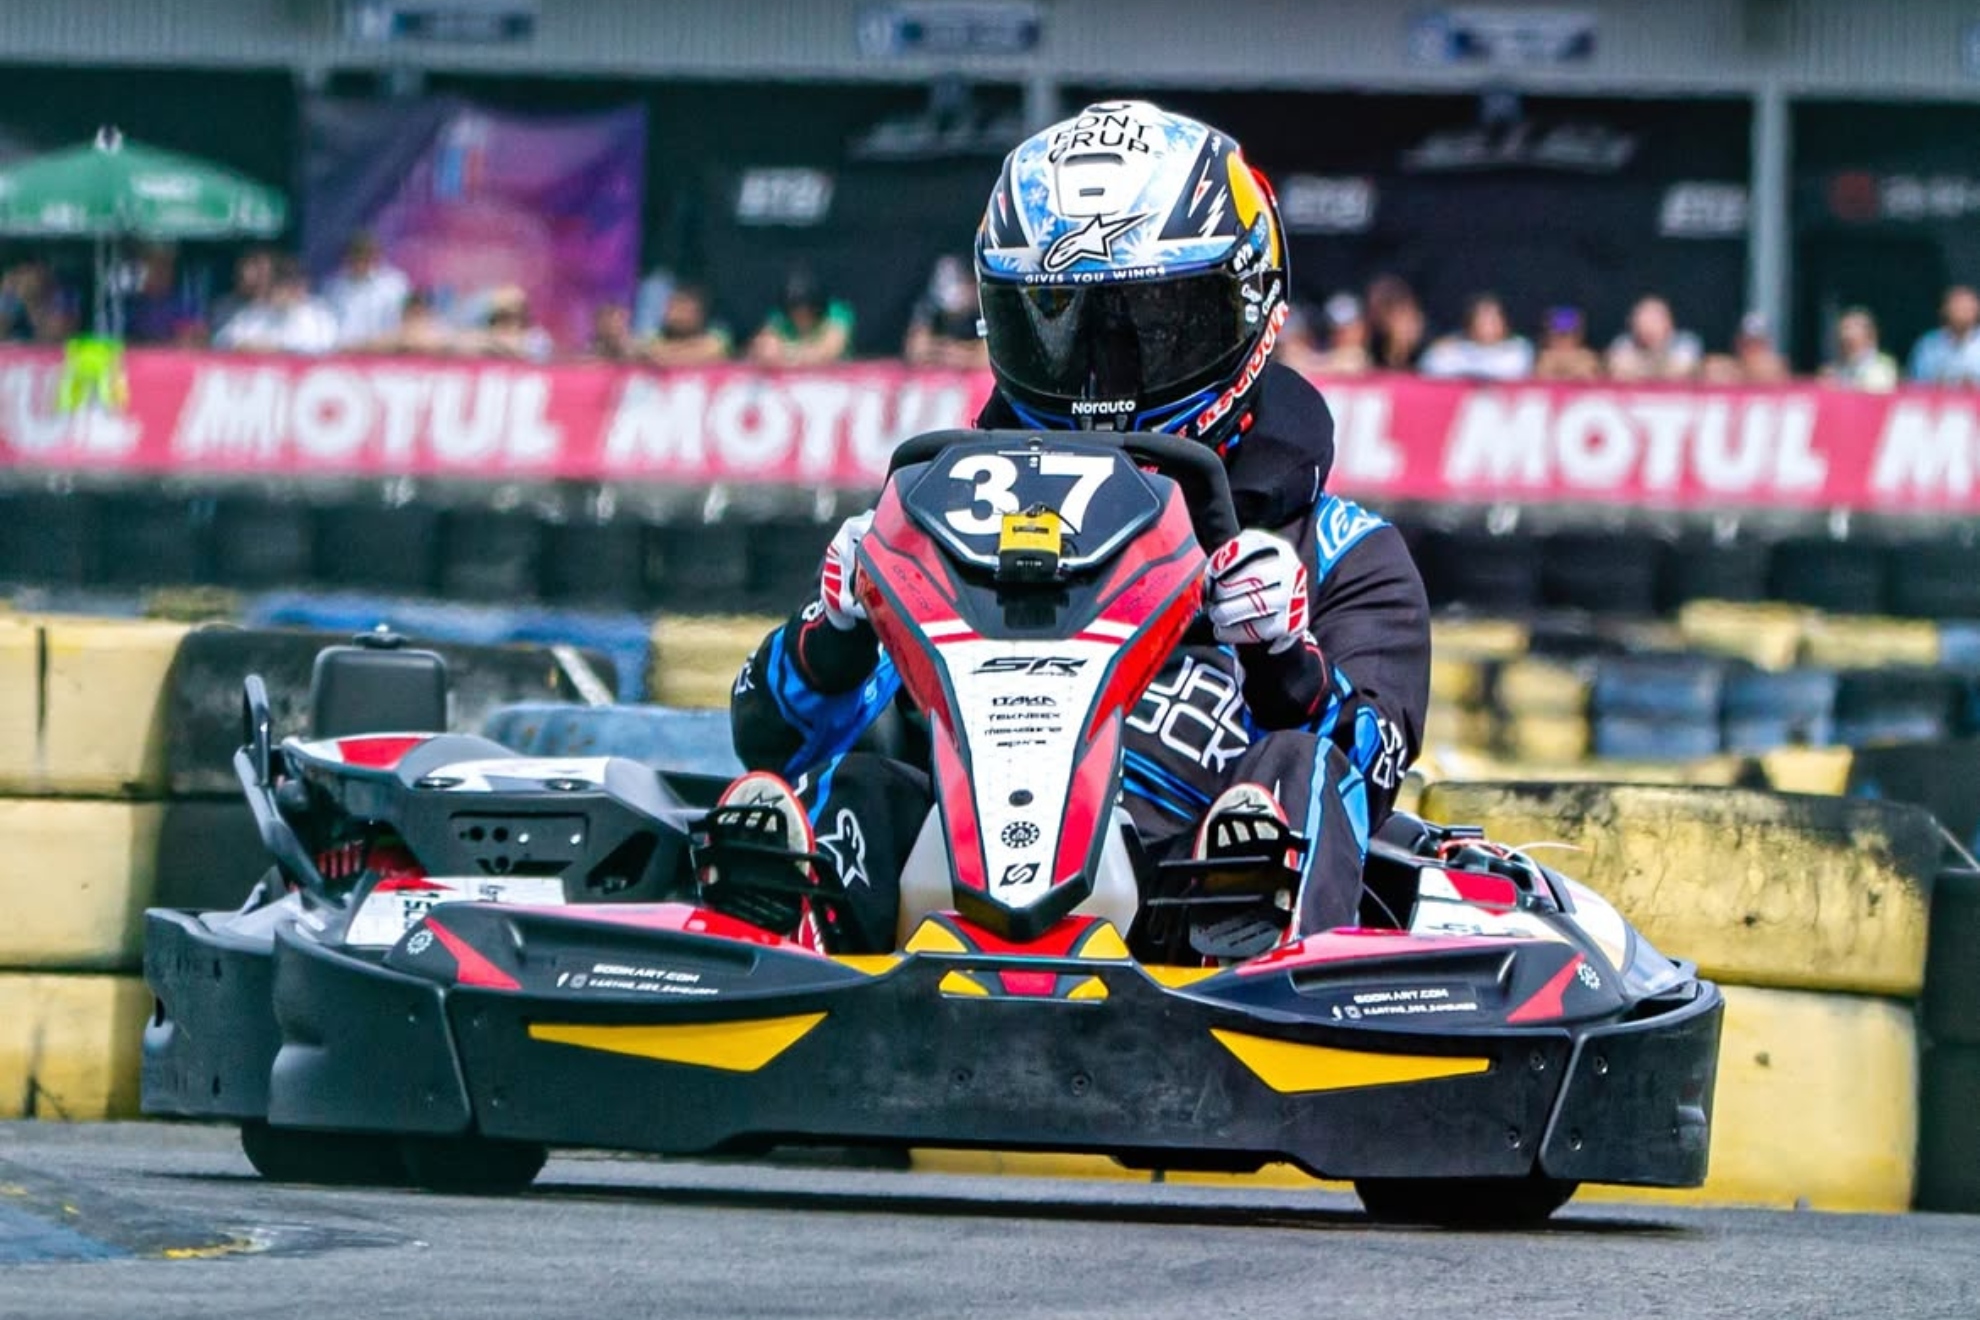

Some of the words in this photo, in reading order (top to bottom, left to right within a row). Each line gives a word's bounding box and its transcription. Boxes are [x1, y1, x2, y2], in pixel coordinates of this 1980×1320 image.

[1025, 273, 1064, 284] GIVES
[1072, 272, 1104, 283] YOU
[1113, 266, 1166, 280] WINGS
[174, 364, 563, 462] MOTUL
[1071, 400, 1136, 415] Norauto
[1443, 386, 1828, 490] MOTUL
[944, 454, 1115, 535] 37
